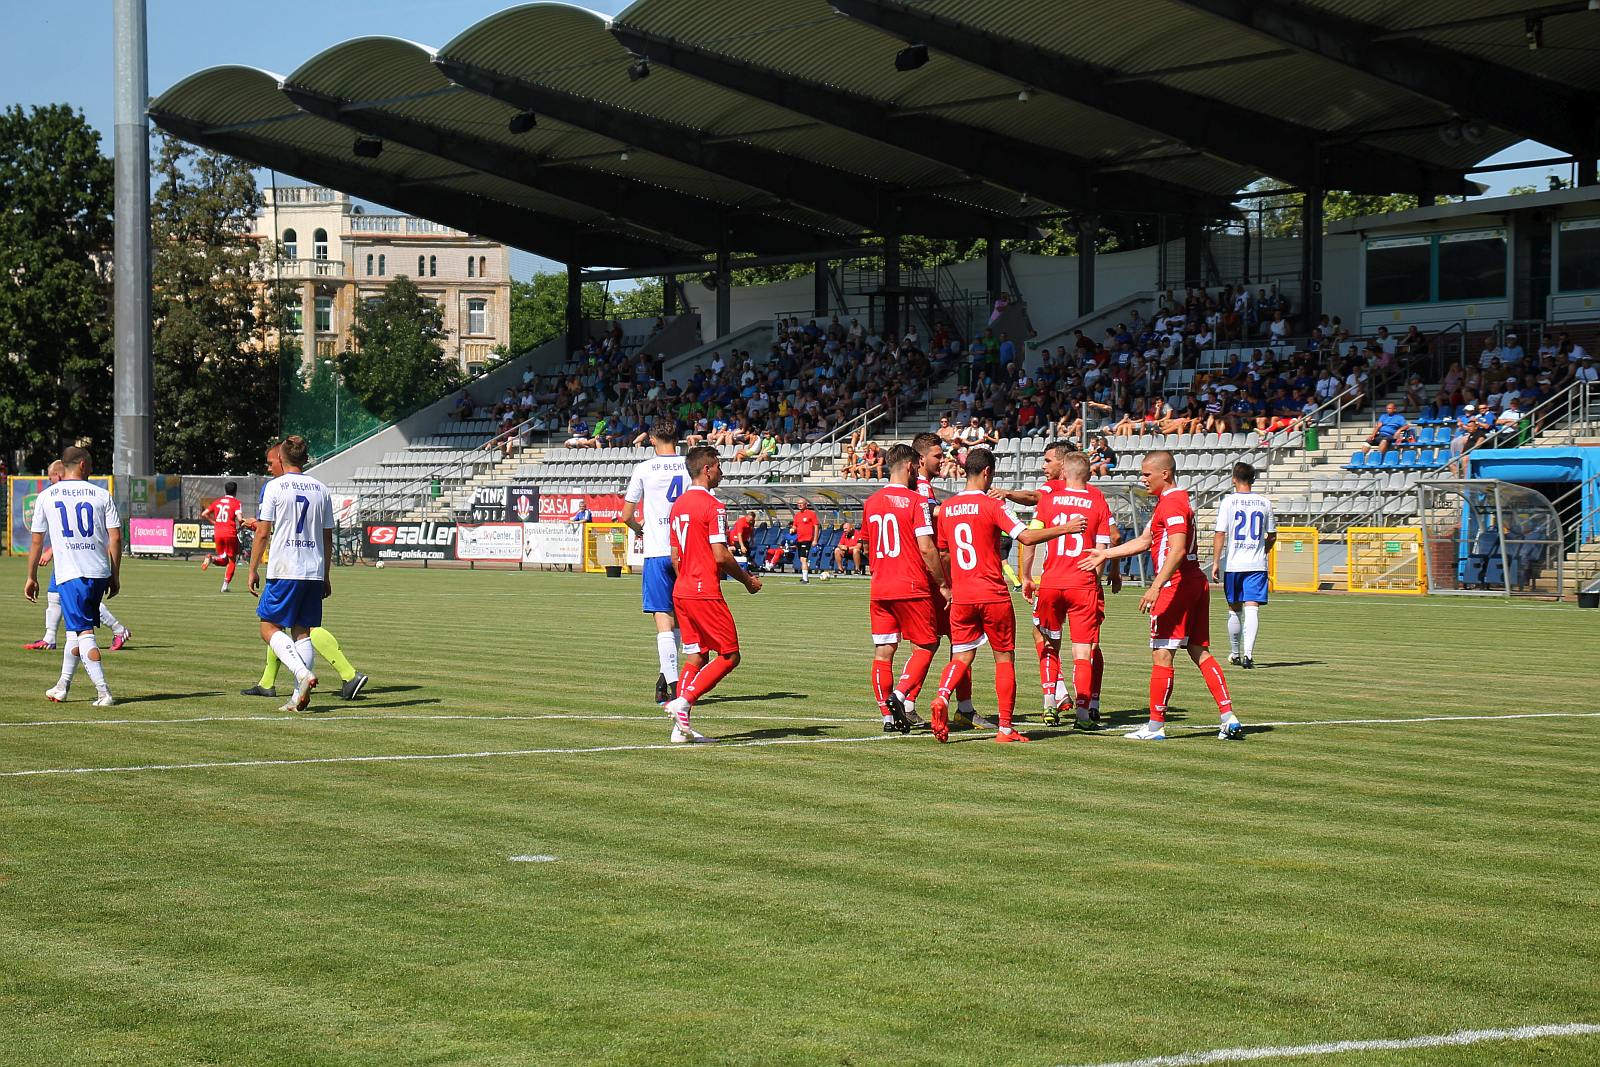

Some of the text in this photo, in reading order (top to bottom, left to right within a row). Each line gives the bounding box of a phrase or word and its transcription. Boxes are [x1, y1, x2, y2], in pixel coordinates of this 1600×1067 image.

[651, 463, 661, 471] KP
[50, 488, 59, 497] KP
[280, 482, 290, 491] KP
[666, 475, 683, 502] 4
[215, 503, 230, 523] 26
[295, 494, 310, 534] 7
[945, 503, 979, 518] M.GARCIA
[1052, 495, 1093, 509] PURZYCKI
[54, 500, 95, 538] 10
[1234, 509, 1265, 541] 20
[394, 521, 457, 546] saller
[868, 512, 901, 558] 20
[954, 522, 978, 571] 8
